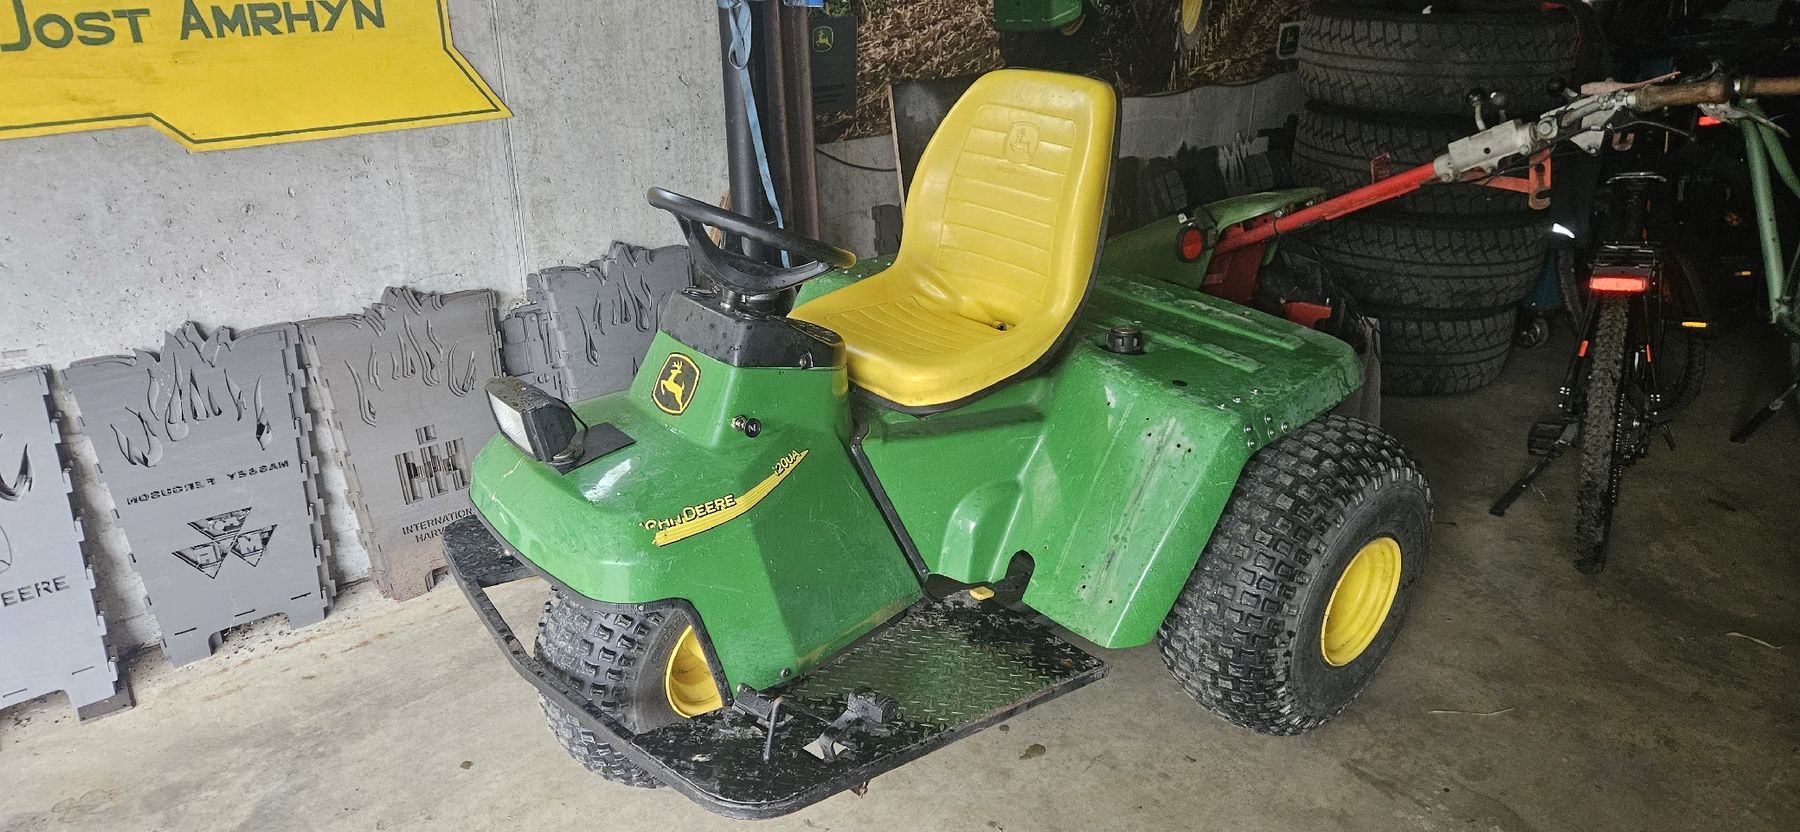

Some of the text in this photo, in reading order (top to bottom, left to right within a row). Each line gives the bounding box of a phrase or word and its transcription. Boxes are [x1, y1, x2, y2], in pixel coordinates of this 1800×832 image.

[402, 507, 473, 536] INTERNATION
[639, 493, 738, 532] OHN DEERE
[416, 525, 447, 543] HARV
[0, 575, 70, 607] EERE
